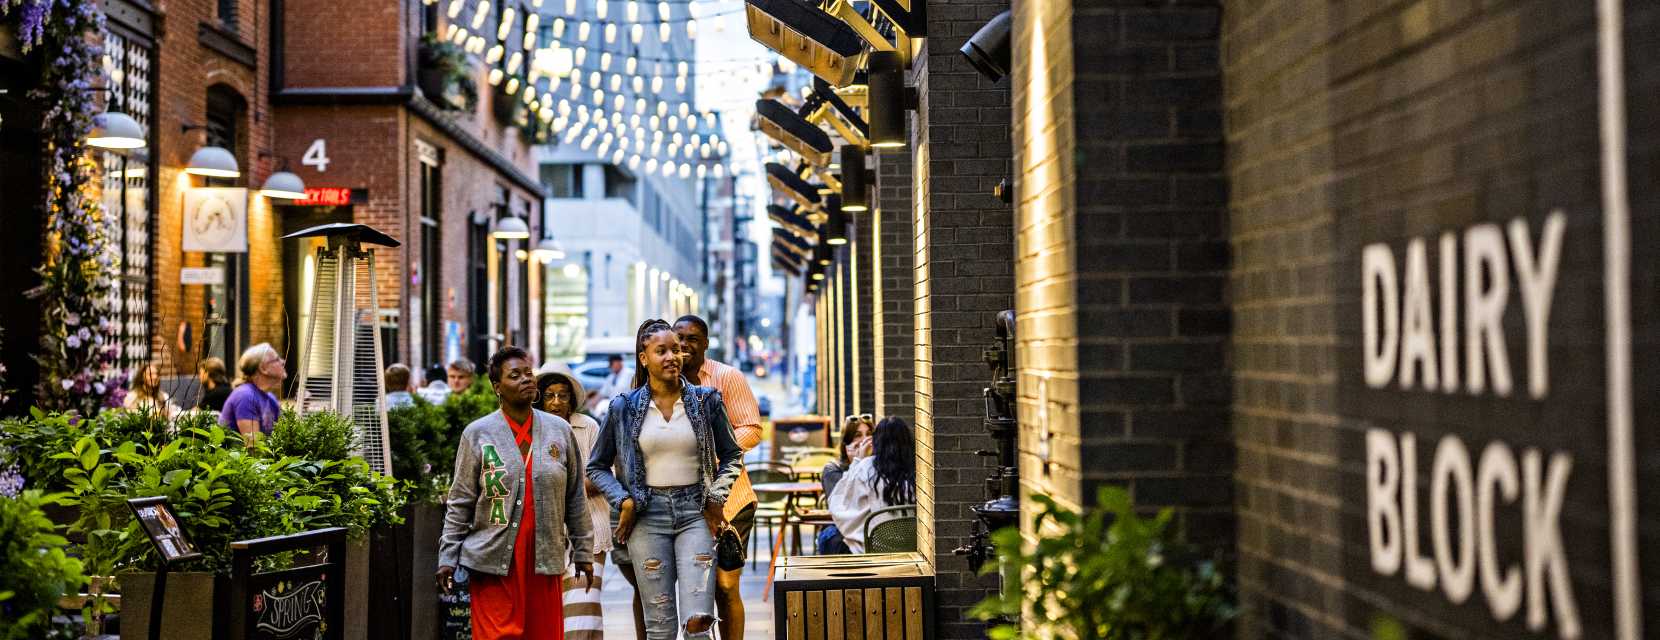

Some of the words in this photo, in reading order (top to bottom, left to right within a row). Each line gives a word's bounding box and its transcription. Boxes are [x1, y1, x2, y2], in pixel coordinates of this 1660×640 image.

[302, 139, 330, 171] 4
[1362, 210, 1567, 400] DAIRY
[481, 444, 510, 526] AKA
[1366, 427, 1582, 640] BLOCK
[271, 587, 312, 628] SPRING
